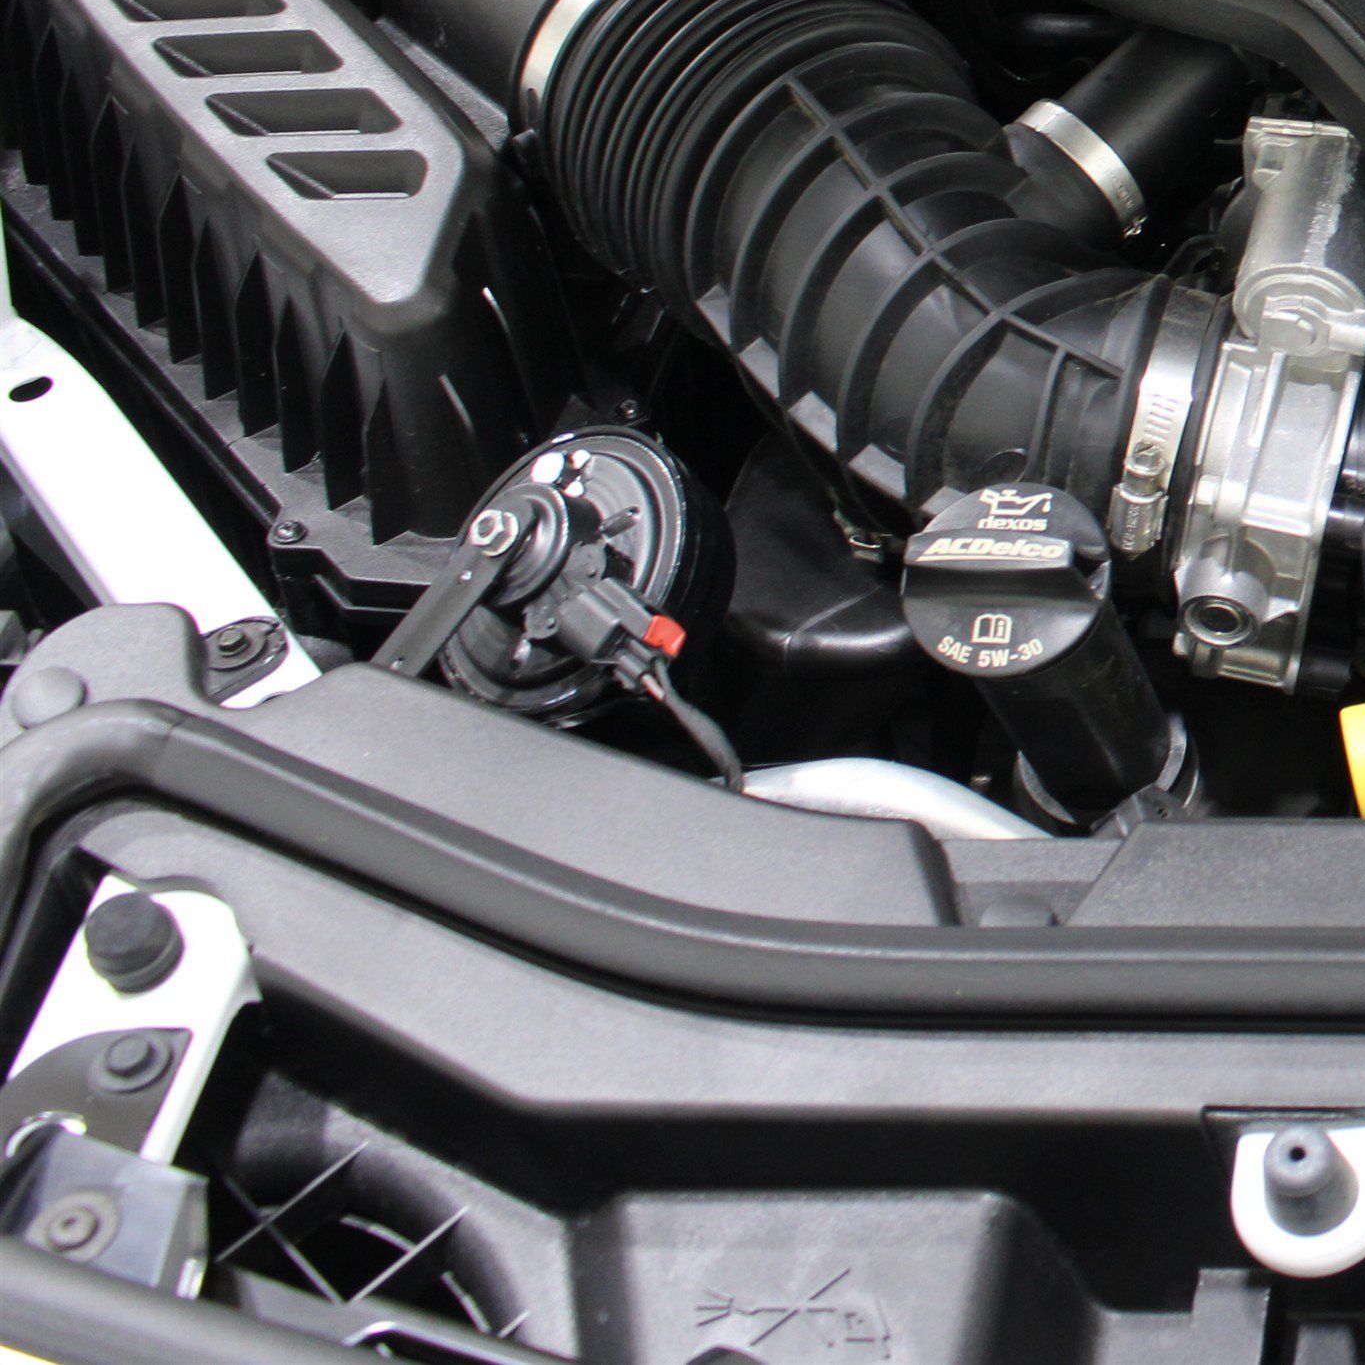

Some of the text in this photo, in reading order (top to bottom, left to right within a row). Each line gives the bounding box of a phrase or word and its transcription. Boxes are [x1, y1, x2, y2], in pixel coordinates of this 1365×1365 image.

[976, 515, 1049, 532] dexos
[922, 537, 1065, 559] ACDelco
[936, 635, 1044, 668] SAE 5W-30
